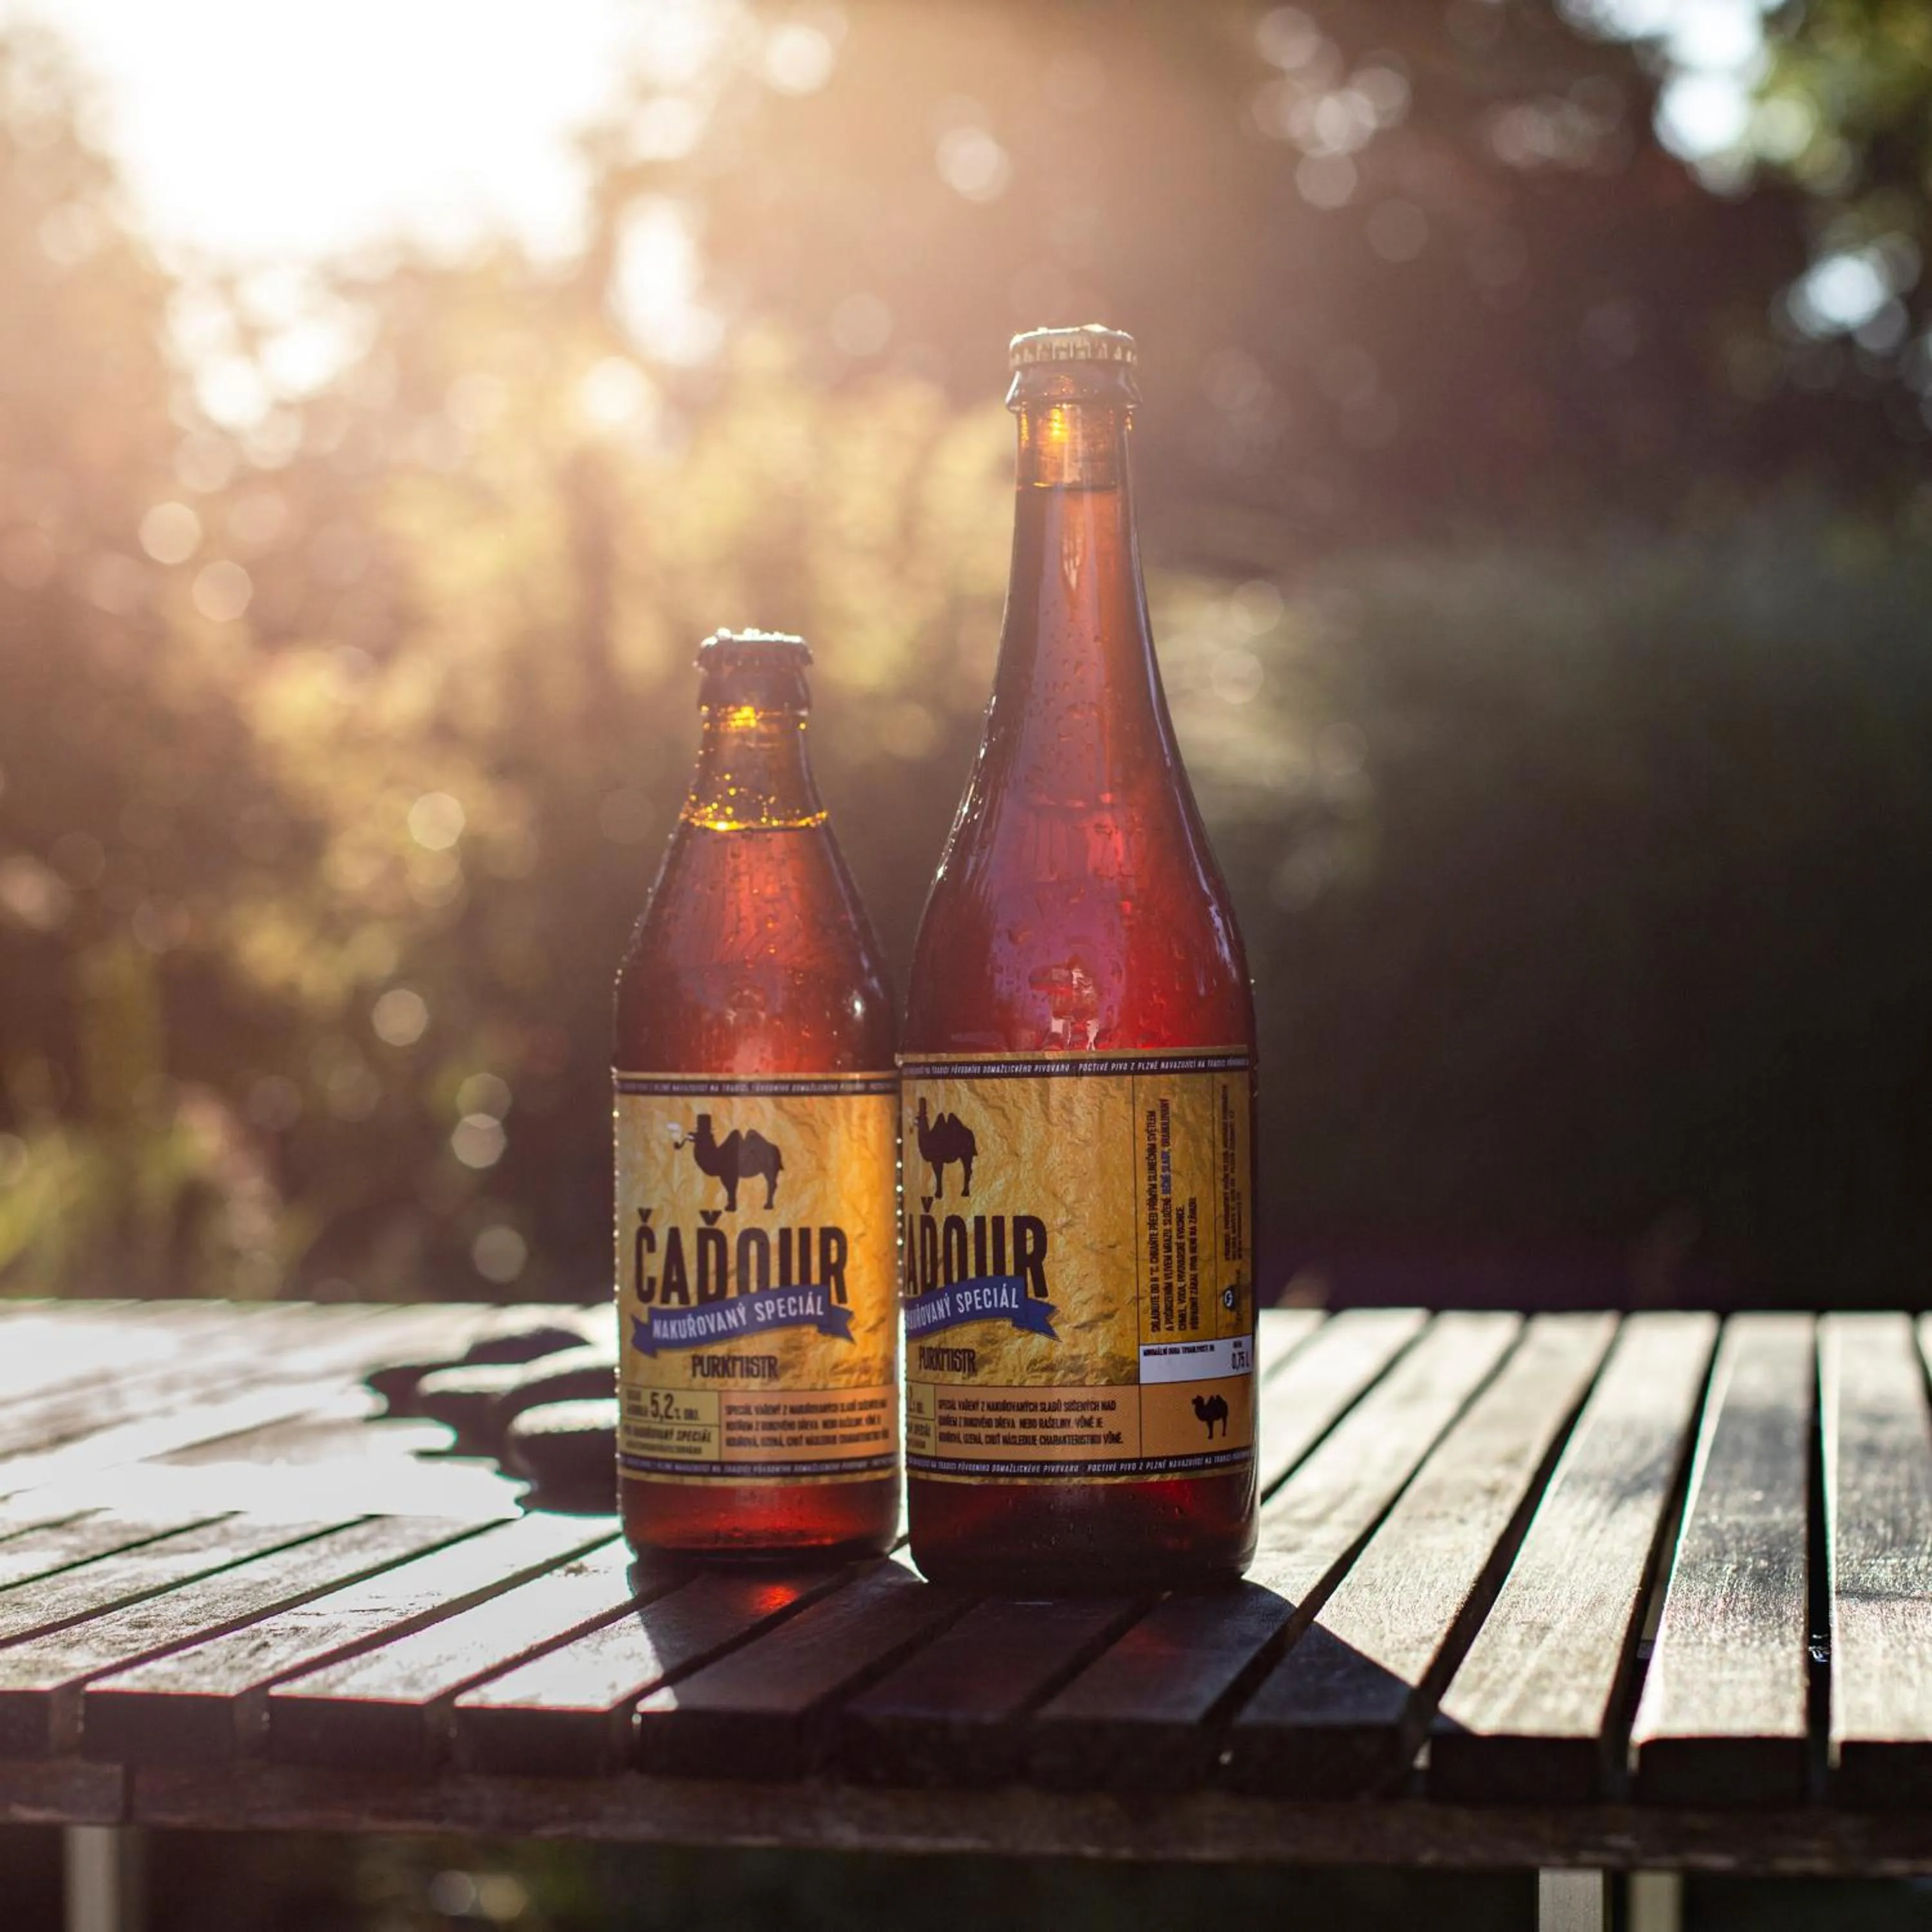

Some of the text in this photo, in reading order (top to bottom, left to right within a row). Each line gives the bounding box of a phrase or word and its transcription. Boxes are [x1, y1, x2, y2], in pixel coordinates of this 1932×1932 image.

[1034, 1063, 1070, 1073] PIVOVARU
[1078, 1061, 1108, 1072] POCTIVÉ
[1111, 1063, 1128, 1072] PIVO
[635, 1208, 848, 1305] ČAĎOUR
[905, 1196, 1049, 1298] AĎOUR
[956, 1283, 1019, 1313] SPECIÁL
[652, 1291, 824, 1340] NAKUŘOVANÝ SPECIÁL
[650, 1391, 674, 1422] 5,2
[1087, 1461, 1117, 1472] POCTIVÉ
[1120, 1463, 1137, 1472] PIVO
